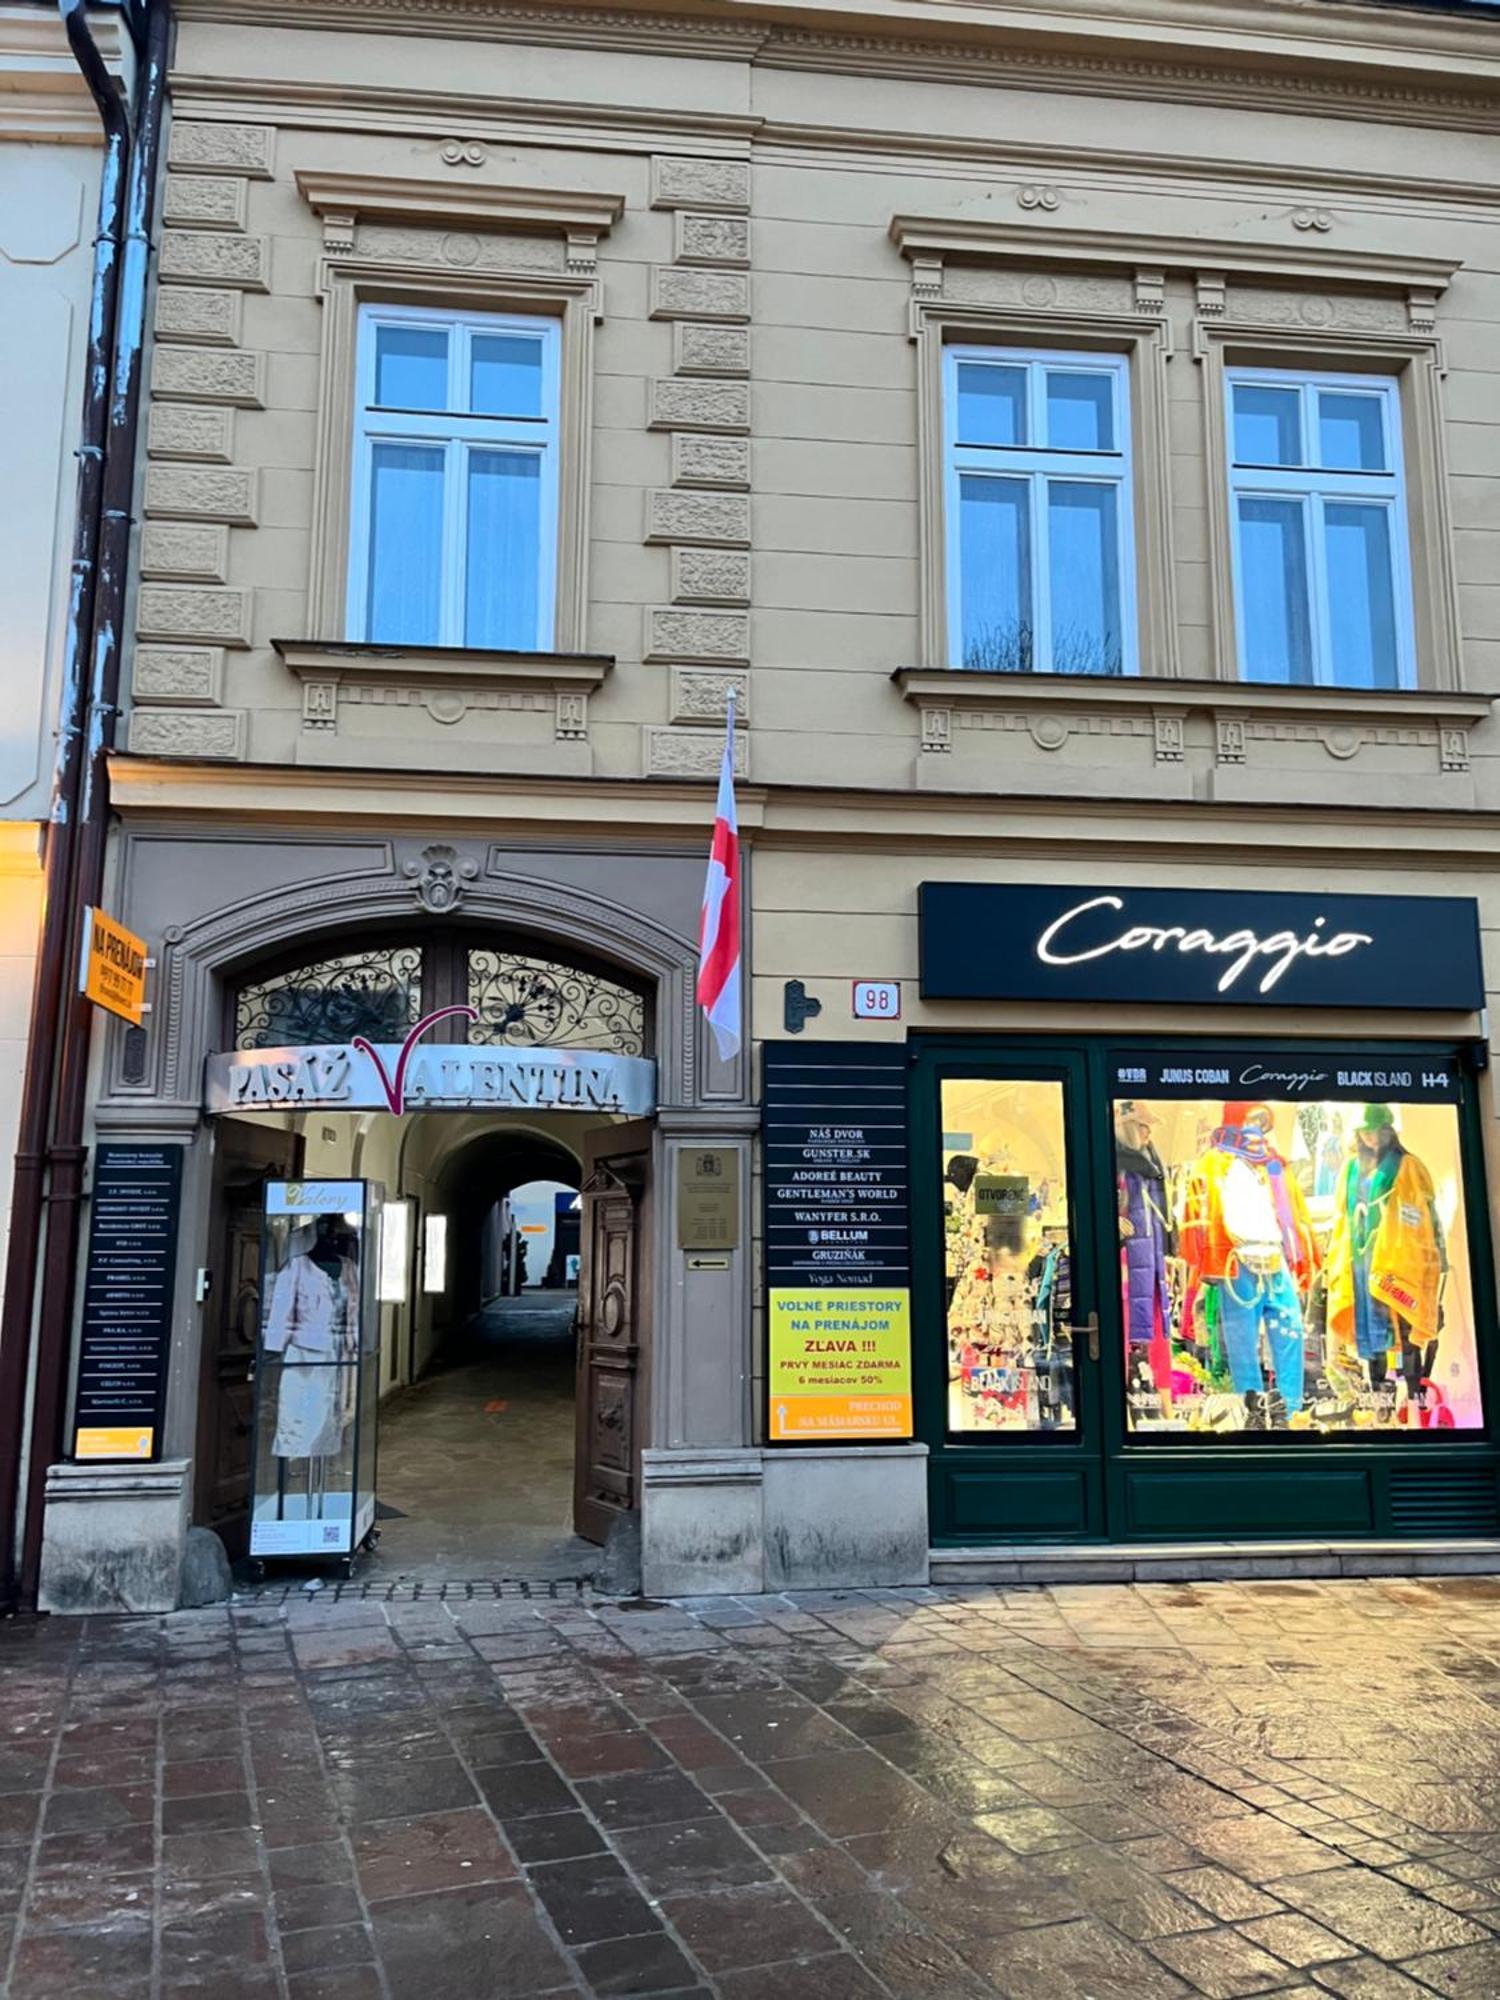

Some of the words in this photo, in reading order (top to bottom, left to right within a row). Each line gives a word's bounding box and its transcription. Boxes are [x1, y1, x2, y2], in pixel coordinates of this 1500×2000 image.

[1036, 895, 1374, 994] Coraggio
[866, 990, 888, 1010] 98
[229, 1050, 352, 1105] PASÁŽ
[352, 1005, 625, 1118] VALENTINA
[1195, 1069, 1230, 1084] COBAN
[1239, 1064, 1328, 1091] Coraggio
[809, 1127, 832, 1139] NÁŠ
[834, 1128, 864, 1140] DVOR
[840, 1171, 882, 1183] BEAUTY
[857, 1189, 898, 1200] WORLD
[794, 1211, 848, 1222] WANYFER
[850, 1212, 882, 1223] S.R.O.
[820, 1230, 869, 1241] BELLUM
[826, 1300, 902, 1312] PRIESTORY
[791, 1319, 811, 1331] NA
[814, 1317, 890, 1331] PRENÁJOM
[861, 1339, 877, 1353] !!!
[811, 1360, 853, 1370] MESIAC
[856, 1359, 901, 1370] ZDARMA
[798, 1375, 806, 1385] 6
[808, 1376, 858, 1385] mesiacov
[860, 1375, 883, 1385] 50%
